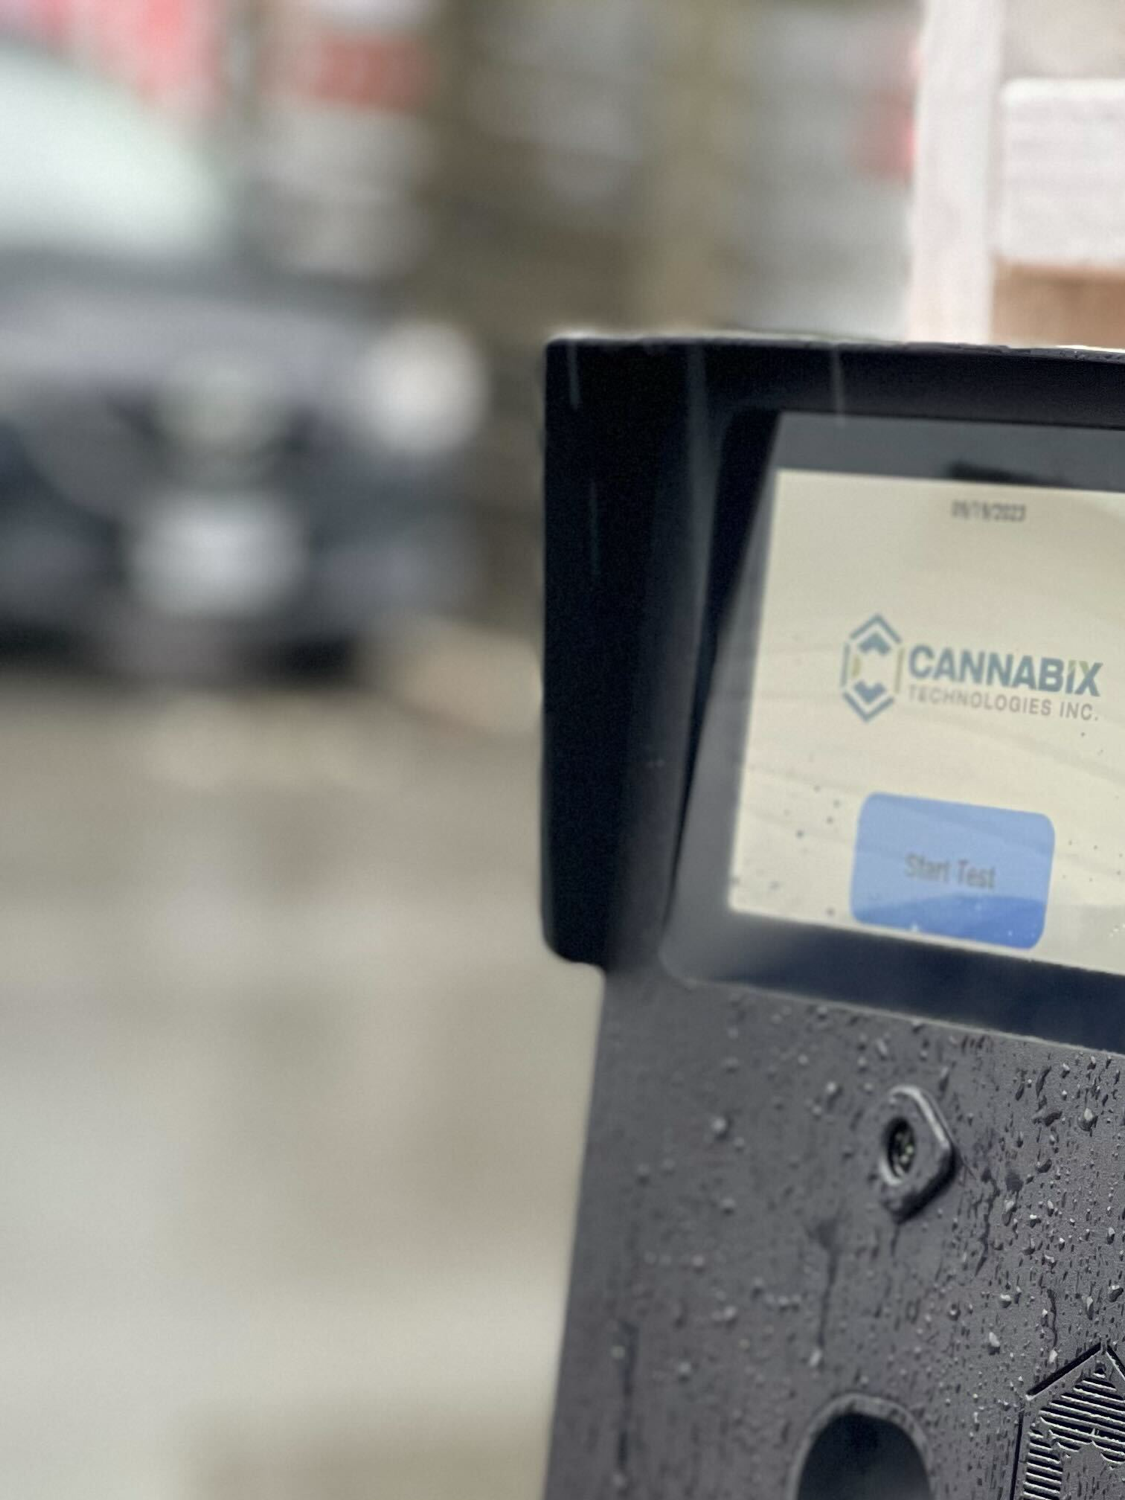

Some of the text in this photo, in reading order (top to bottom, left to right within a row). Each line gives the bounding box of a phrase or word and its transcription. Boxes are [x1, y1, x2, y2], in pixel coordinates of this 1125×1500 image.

[908, 643, 1104, 698] CANNABIX
[908, 683, 1099, 722] TECHNOLOGIES INC.
[904, 852, 996, 890] Start Test
